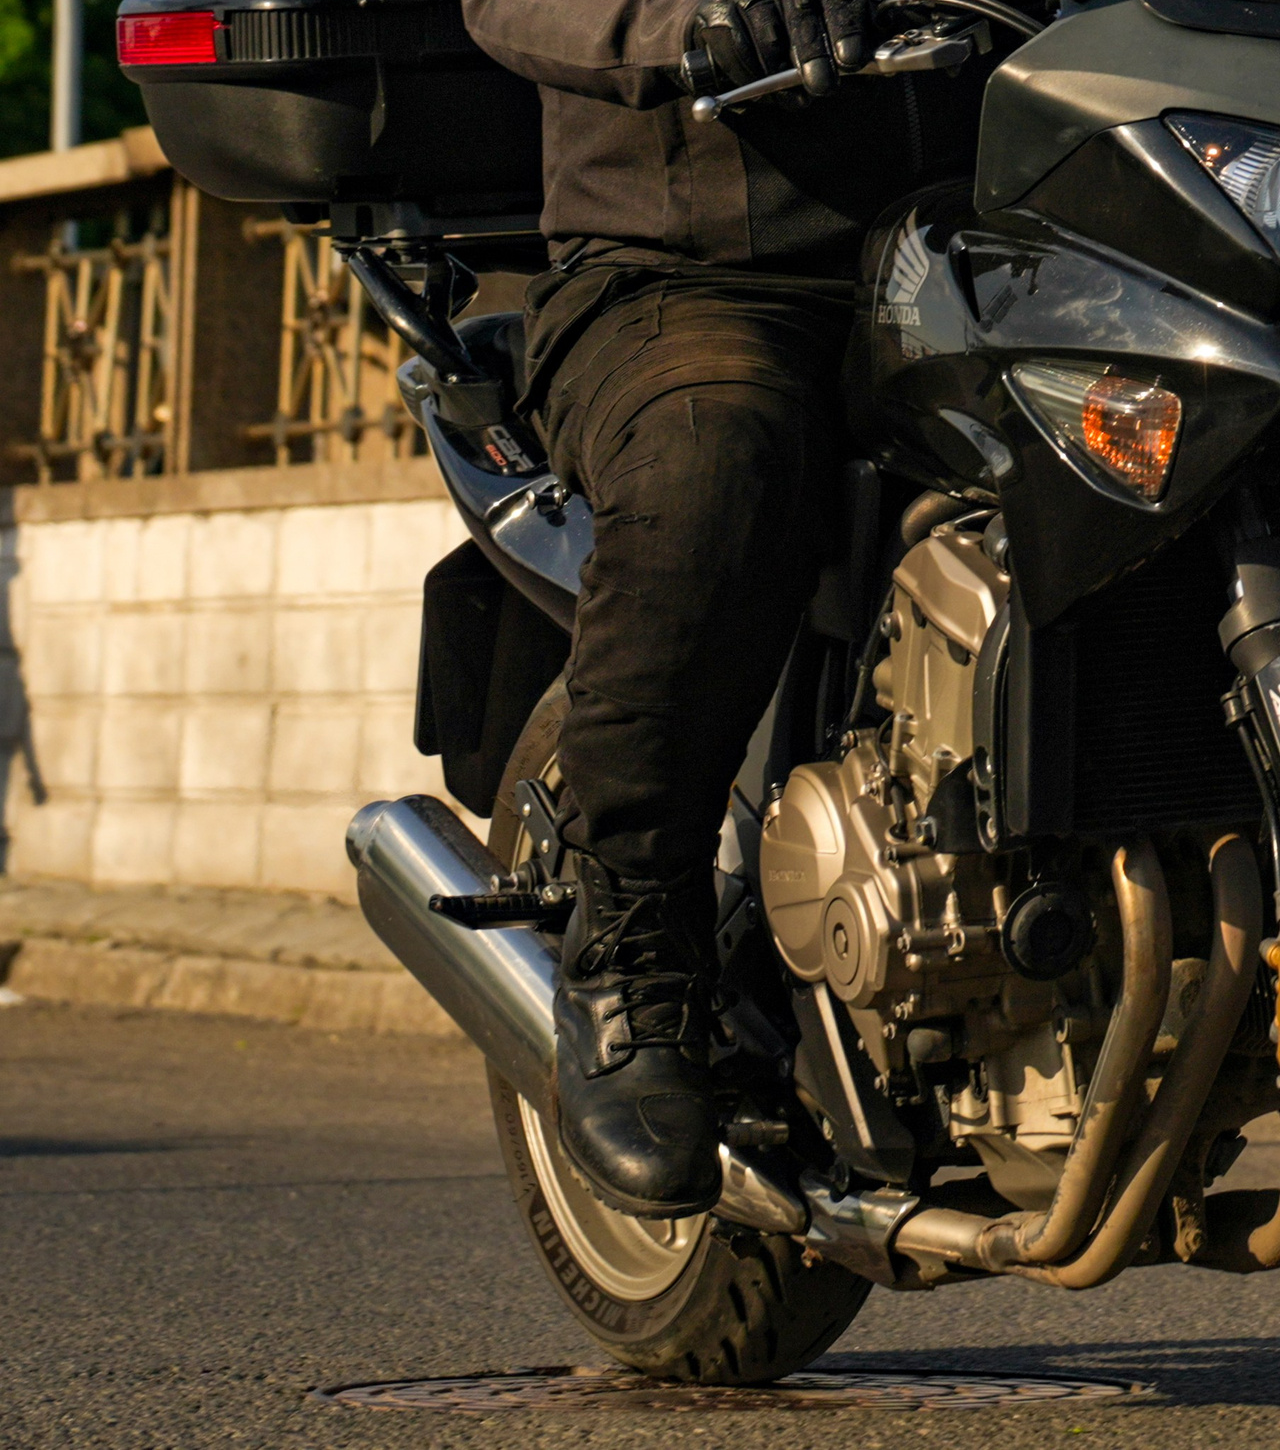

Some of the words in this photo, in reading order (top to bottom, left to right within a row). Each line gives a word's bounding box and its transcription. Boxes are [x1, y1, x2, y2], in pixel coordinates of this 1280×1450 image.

[877, 305, 921, 326] HONDA
[487, 426, 535, 471] CBF
[533, 1210, 623, 1327] MICHELIN
